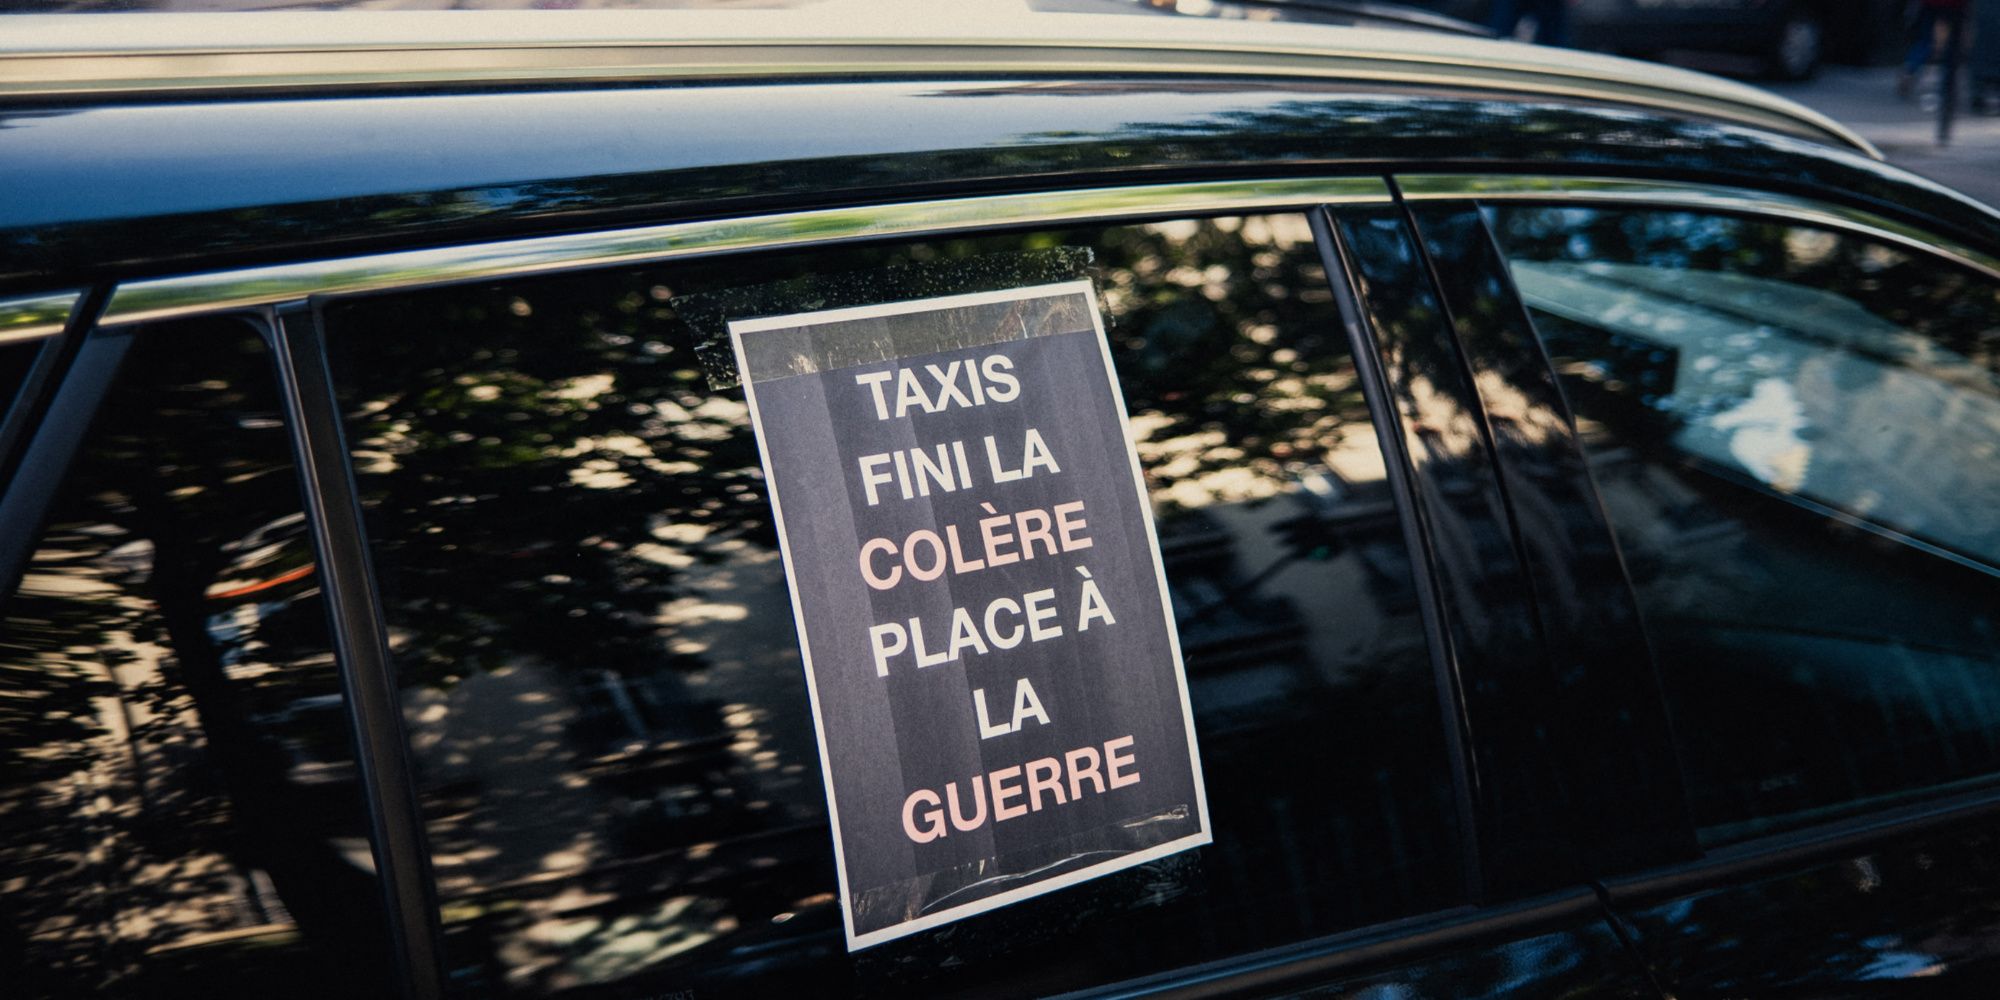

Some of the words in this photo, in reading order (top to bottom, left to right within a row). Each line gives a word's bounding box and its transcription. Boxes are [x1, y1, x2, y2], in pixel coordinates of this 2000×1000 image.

[855, 354, 1021, 421] TAXIS
[857, 440, 973, 506] FINI
[983, 427, 1061, 485] LA
[858, 500, 1094, 591] COLÈRE
[867, 587, 1064, 679] PLACE
[1075, 565, 1117, 633] À
[972, 676, 1051, 741] LA
[901, 735, 1141, 844] GUERRE
